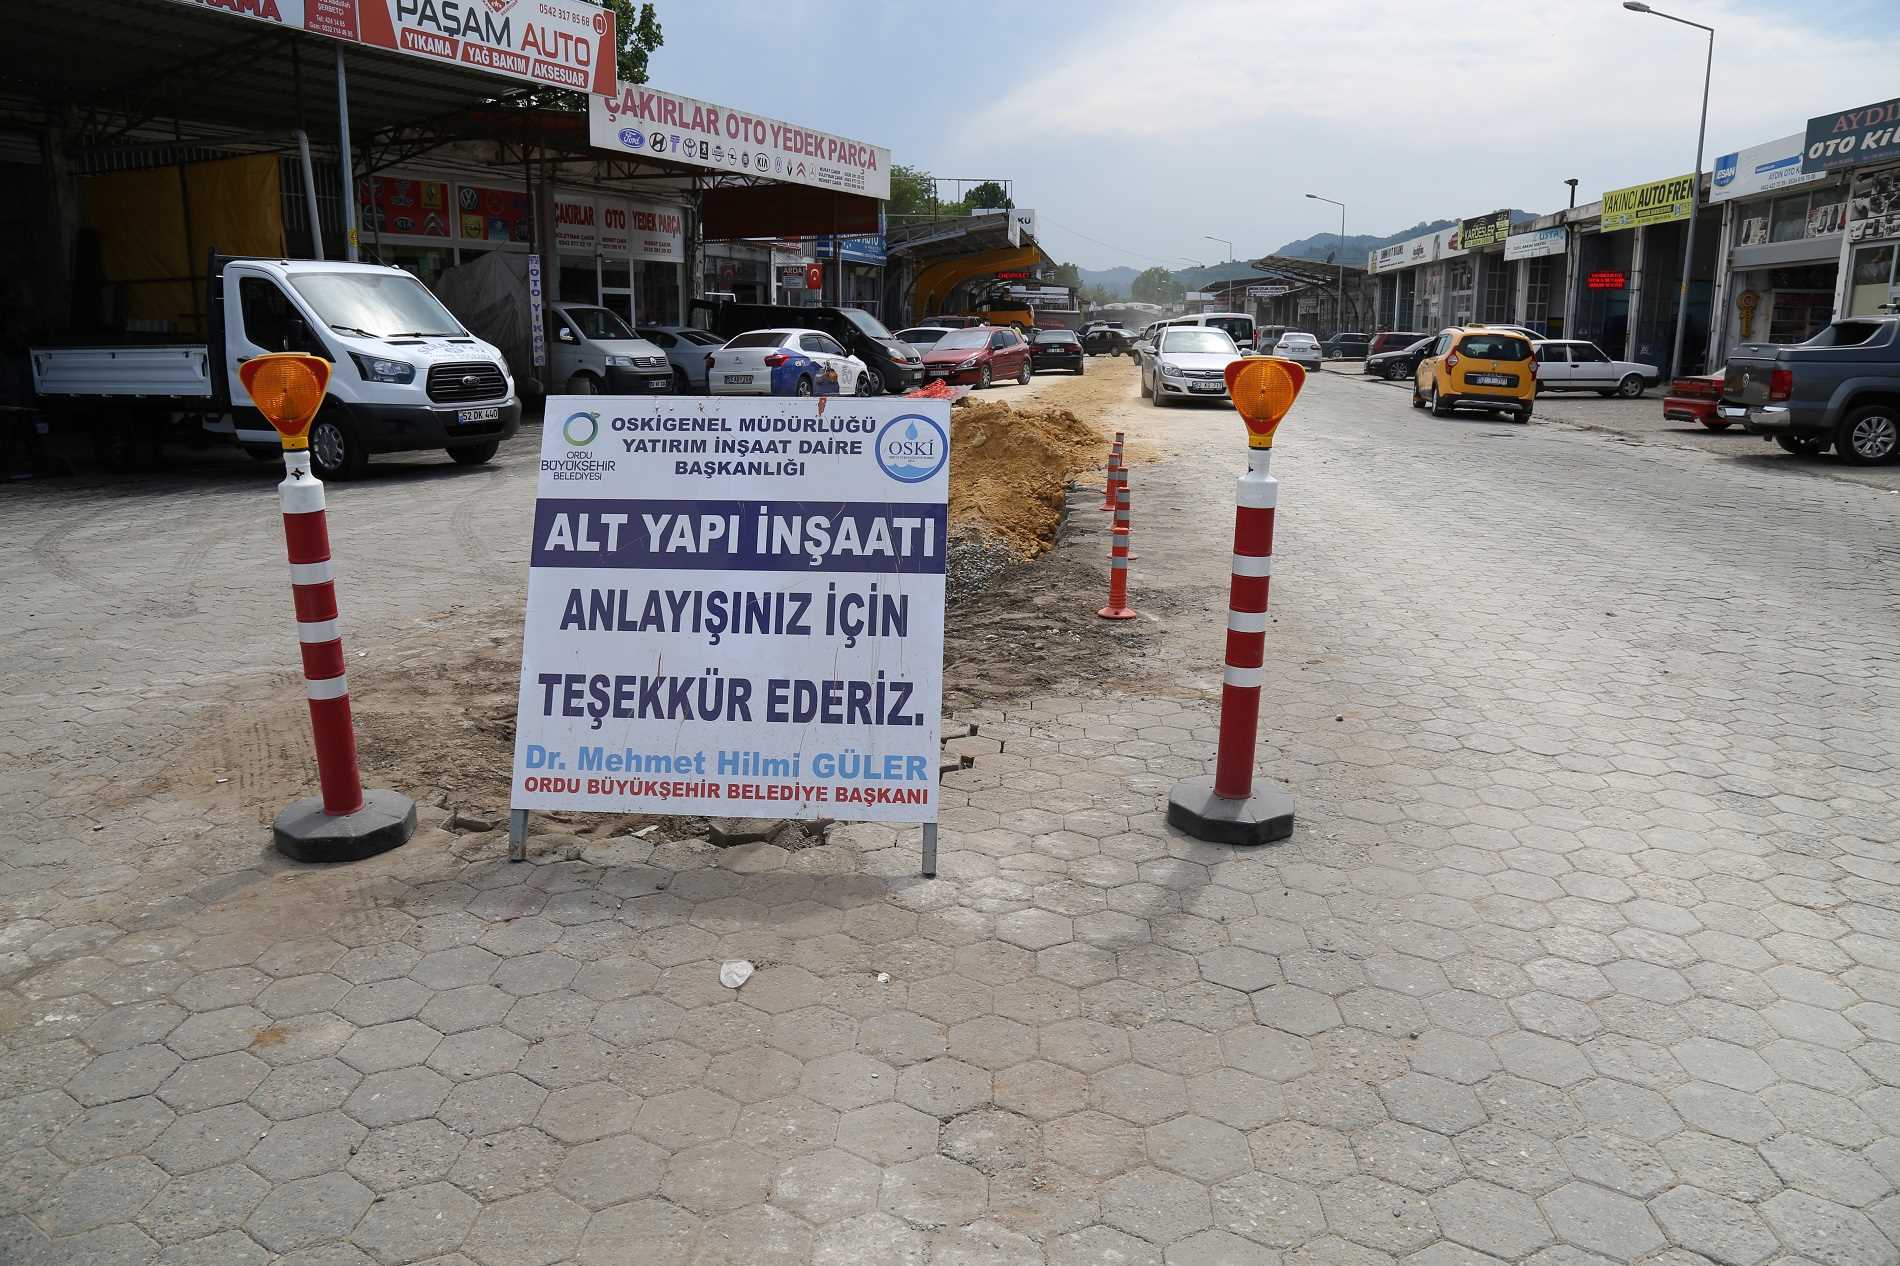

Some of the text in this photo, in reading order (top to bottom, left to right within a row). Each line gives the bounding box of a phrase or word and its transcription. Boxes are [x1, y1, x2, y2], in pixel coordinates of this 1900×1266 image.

[539, 4, 590, 26] 0542 317 85 68
[397, 0, 591, 67] PAŞAM AUTO
[405, 32, 585, 86] YIKAMA YAĞ BAKIM AKSESUAR
[604, 87, 877, 174] ÇAKIRLAR OTO YEDEK PARÇA
[1832, 103, 1900, 133] AYDI
[1808, 136, 1856, 159] OTO
[1604, 191, 1638, 214] YAKINCI
[1637, 184, 1666, 208] AUTO
[1666, 178, 1695, 202] FREN
[554, 203, 682, 239] ÇAKIRLAR OTO YEDEK PARÇA
[530, 269, 541, 296] OTO
[463, 409, 498, 421] 52 DK 440
[611, 415, 877, 434] OSKİGENEL MÜDÜRLÜĞÜ
[566, 451, 593, 460] ORDU
[622, 436, 862, 459] YATIRIM İNŞAAT DAİRE
[889, 440, 934, 456] OSKİ
[541, 459, 616, 473] BÜYÜKŞEHİR
[674, 460, 806, 479] BAŞKANLIĞI
[544, 505, 935, 566] ALT YAPI İNŞAATI
[559, 582, 909, 648] ANLAYIŞINIZ İÇİN
[538, 668, 924, 729] TEŞEKKÜR EDERİZ.
[526, 744, 928, 781] Dr. Mehmet Hilmi GÜLER
[524, 776, 928, 807] ORDU BÜYÜKŞEHİR BELEDİYE BAŞKANI
